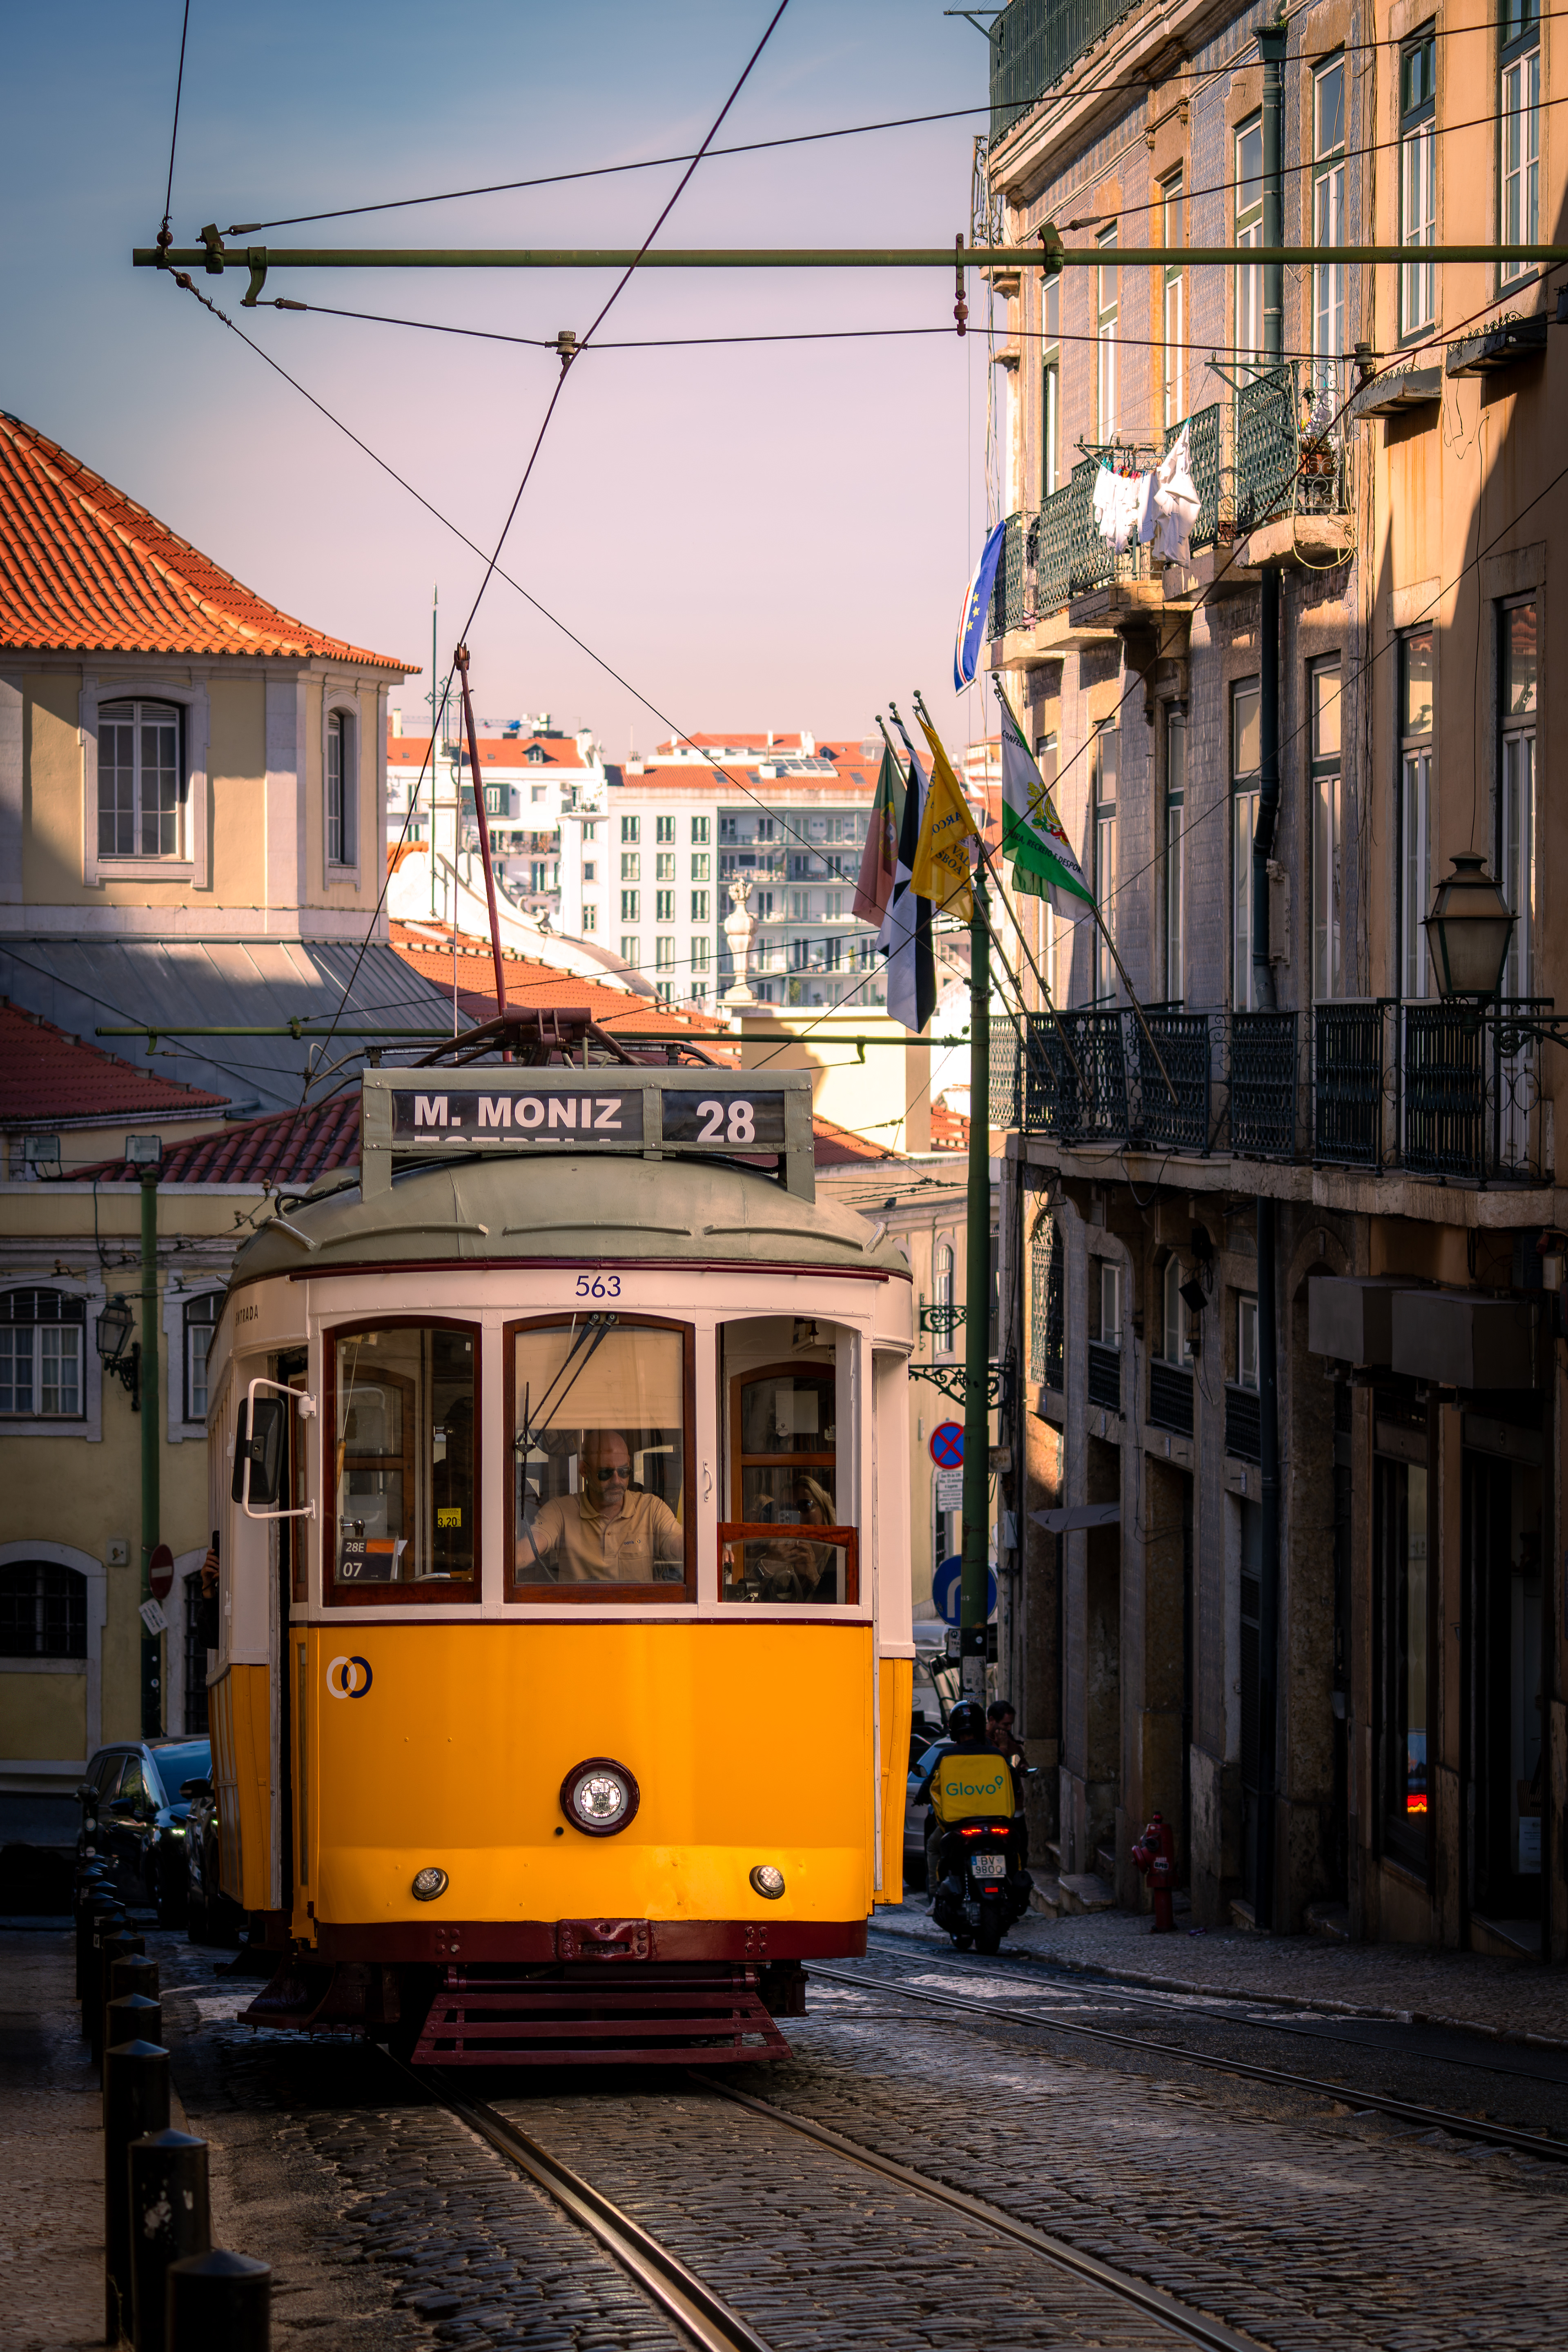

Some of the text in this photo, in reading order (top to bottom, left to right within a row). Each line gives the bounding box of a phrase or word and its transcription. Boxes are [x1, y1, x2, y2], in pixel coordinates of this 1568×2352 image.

[1002, 729, 1026, 750] CONFED
[953, 844, 970, 868] VAL
[1058, 855, 1083, 875] DESPOR
[414, 1096, 622, 1129] M. MONIZ
[696, 1100, 755, 1143] 28
[575, 1275, 621, 1298] 563
[235, 1304, 258, 1327] ENTRADA
[345, 1542, 365, 1552] 28E
[343, 1562, 363, 1577] 07
[946, 1782, 996, 1796] Glovo
[981, 1857, 995, 1865] BV
